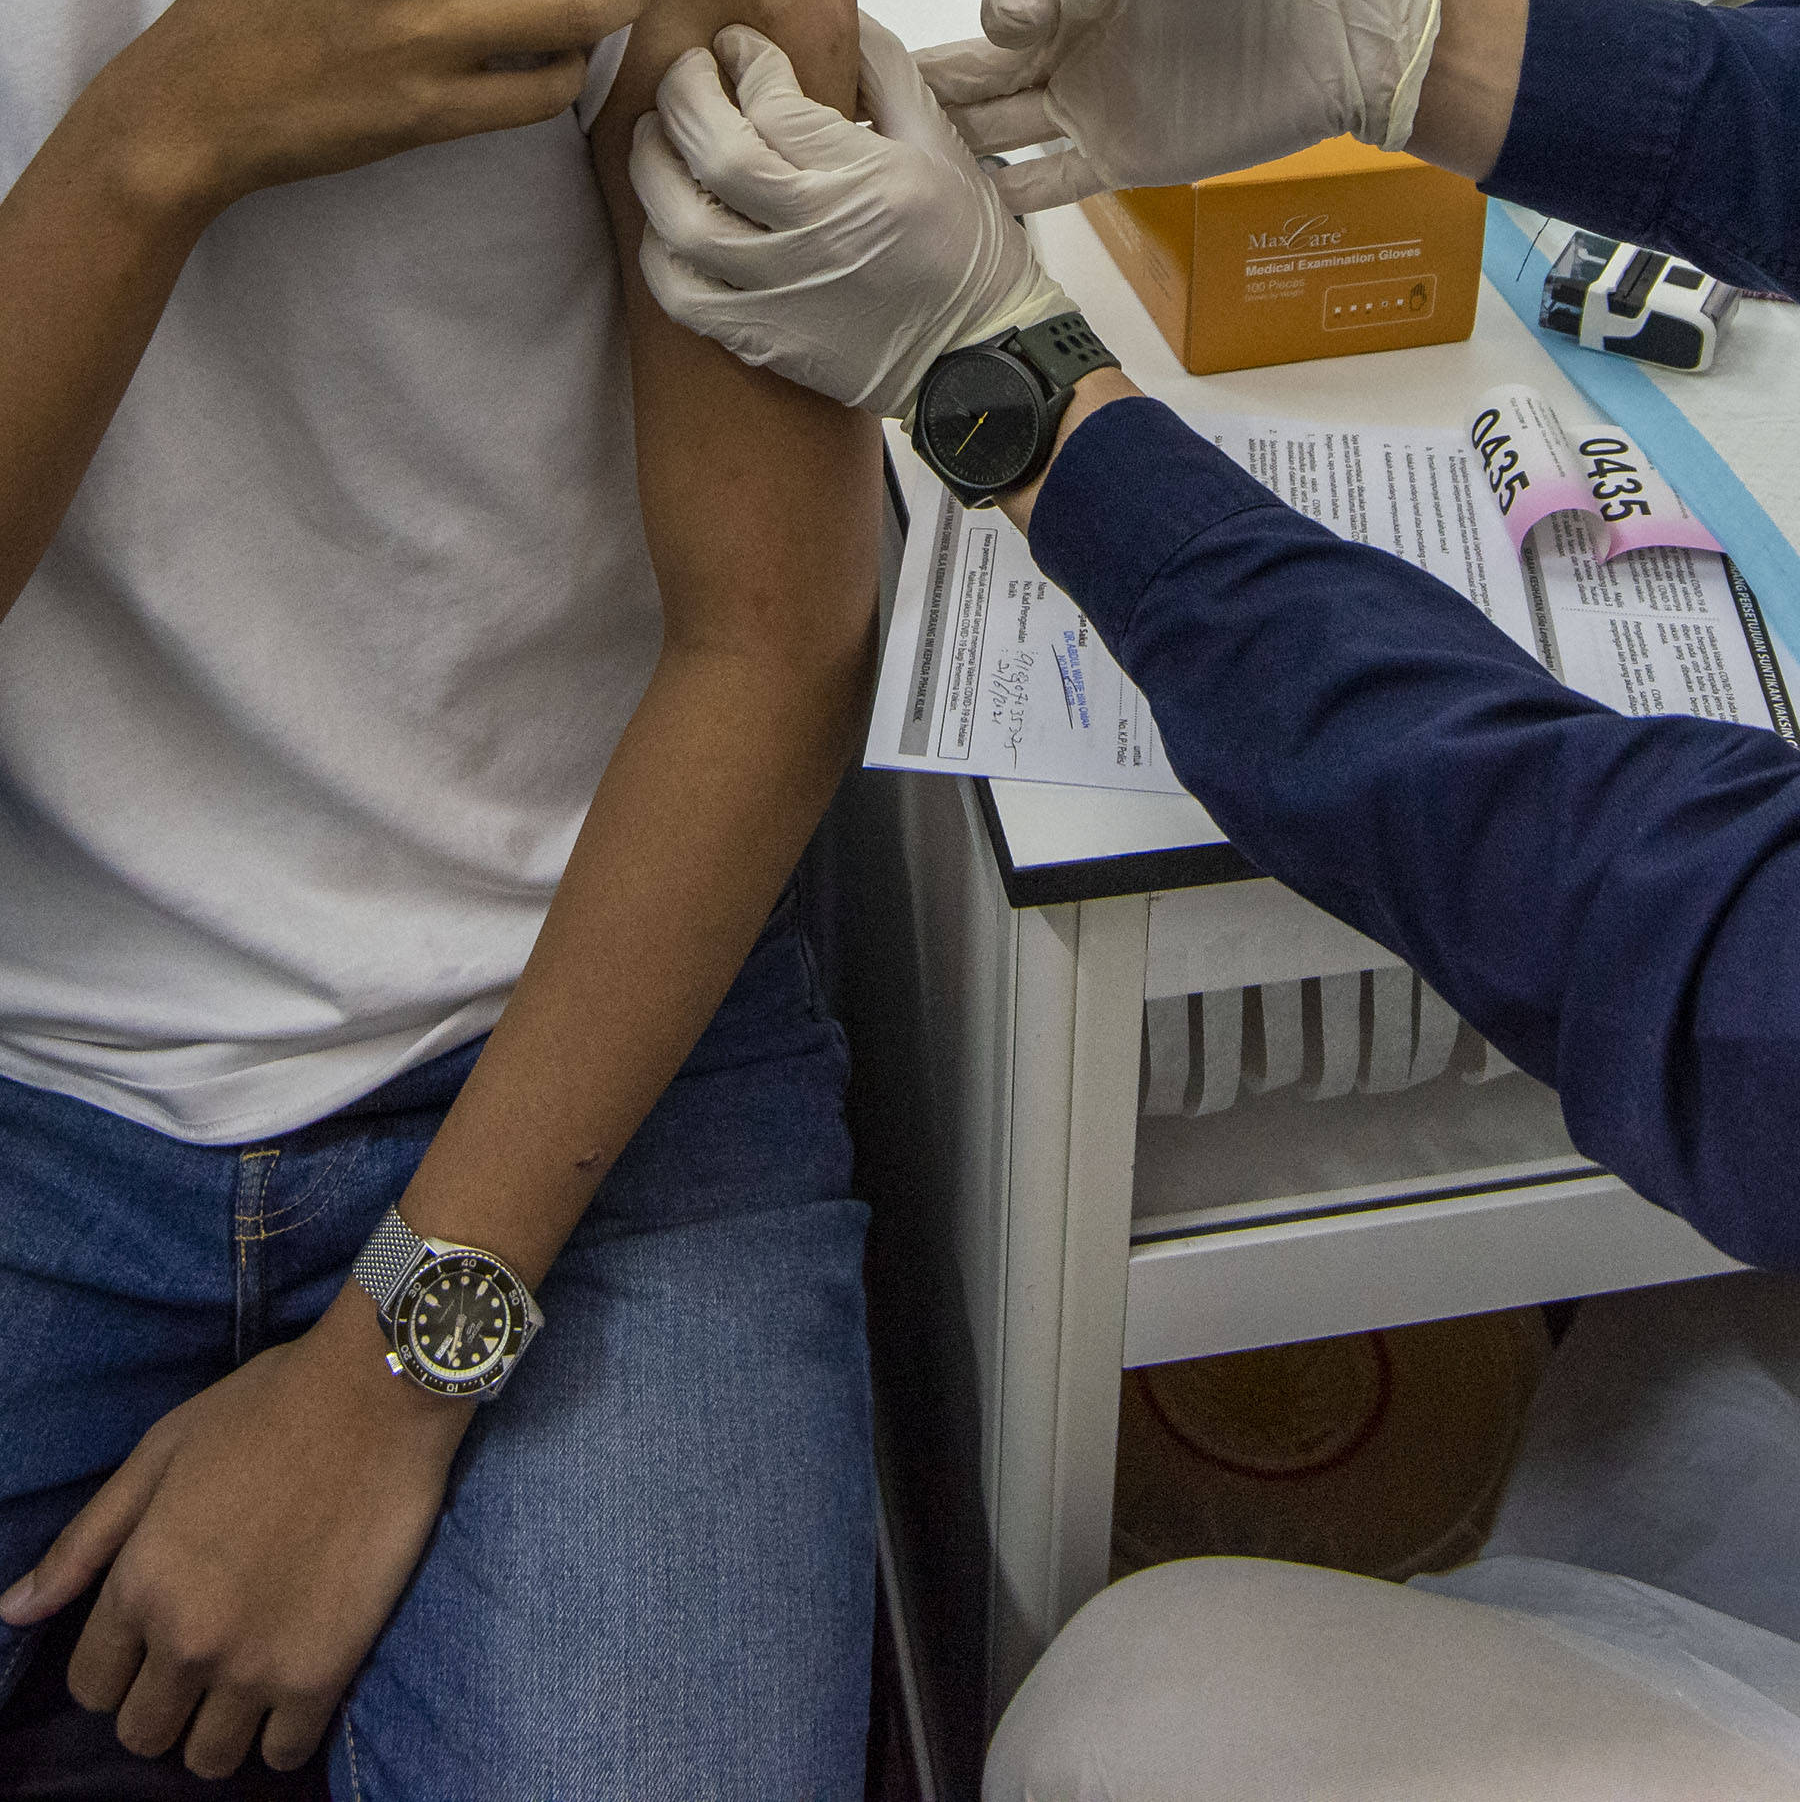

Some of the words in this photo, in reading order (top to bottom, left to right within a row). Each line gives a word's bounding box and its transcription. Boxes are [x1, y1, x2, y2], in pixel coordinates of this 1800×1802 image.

[1245, 260, 1295, 277] Medical
[1298, 253, 1376, 271] Examination
[1378, 246, 1422, 261] Gloves
[1246, 280, 1267, 294] 100
[1472, 408, 1531, 516] 0435
[1579, 437, 1652, 522] 0435
[936, 553, 947, 566] SILA
[1007, 579, 1017, 598] Tarikh
[1022, 580, 1031, 591] No.
[1036, 581, 1045, 599] Nama
[1690, 579, 1706, 605] COVID-19
[972, 587, 986, 616] maklumat
[1021, 592, 1030, 604] Kad
[924, 609, 938, 636] BORANG
[956, 618, 970, 646] COVID-19
[1015, 605, 1029, 643] Pengenalan
[923, 637, 934, 647] INI
[1063, 630, 1075, 642] DR.
[1077, 628, 1087, 647] Saksi
[1704, 625, 1720, 650] Suntikan
[954, 647, 966, 661] bagi
[965, 635, 979, 665] mengenai
[1066, 644, 1079, 667] ABDUL
[1685, 643, 1698, 658] pada
[1711, 650, 1726, 670] Vaksin
[918, 648, 932, 675] KEPADA
[1695, 636, 1713, 670] bergantung
[1705, 672, 1720, 694] kepada
[1737, 592, 1767, 651] PERSETUJUAN
[1756, 653, 1783, 700] SUNTIKAN
[1772, 702, 1795, 738] VAKSIN
[914, 676, 927, 696] PIHAK
[963, 666, 975, 685] Vaksin
[1717, 671, 1734, 700] COVID-19
[958, 686, 972, 716] COVID-19
[1117, 718, 1127, 729] No.
[1132, 745, 1142, 767] untuk
[461, 1259, 477, 1268] 40
[508, 1290, 519, 1306] 50
